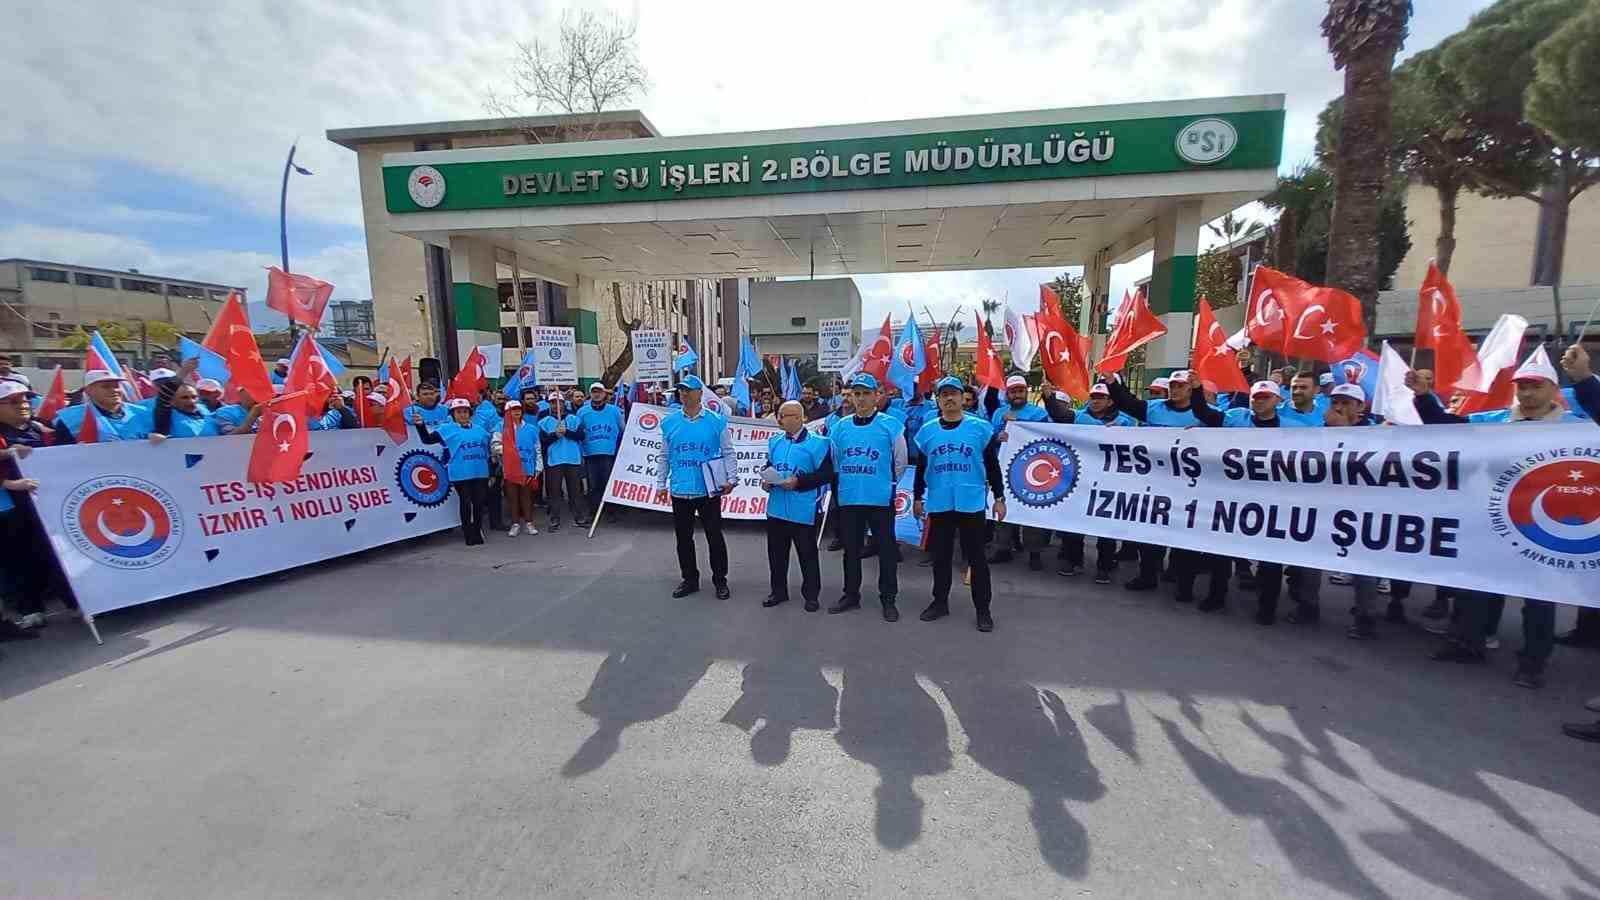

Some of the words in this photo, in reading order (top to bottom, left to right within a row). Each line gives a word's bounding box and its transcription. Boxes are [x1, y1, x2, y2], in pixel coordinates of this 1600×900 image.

[503, 170, 604, 196] DEVLET
[613, 167, 649, 191] SU
[660, 155, 750, 192] İŞLERİ
[904, 130, 1115, 173] MÜDÜRLÜĞÜ
[632, 436, 662, 450] VERG
[1549, 447, 1568, 458] VE
[1573, 446, 1600, 458] GAZ
[626, 463, 643, 474] AZ
[1221, 442, 1461, 491] SENDİKASI
[283, 466, 378, 495] SENDİKASI
[612, 479, 653, 503] VERGİ
[198, 506, 268, 537] İZMİR
[272, 505, 285, 523] 1
[290, 496, 343, 520] NOLU
[347, 488, 392, 513] ŞUBE
[1086, 481, 1172, 526] İZMİR
[1184, 499, 1198, 529] 1
[1211, 500, 1318, 543] NOLU
[1331, 509, 1461, 558] ŞUBE
[1519, 548, 1575, 570] ANKARA
